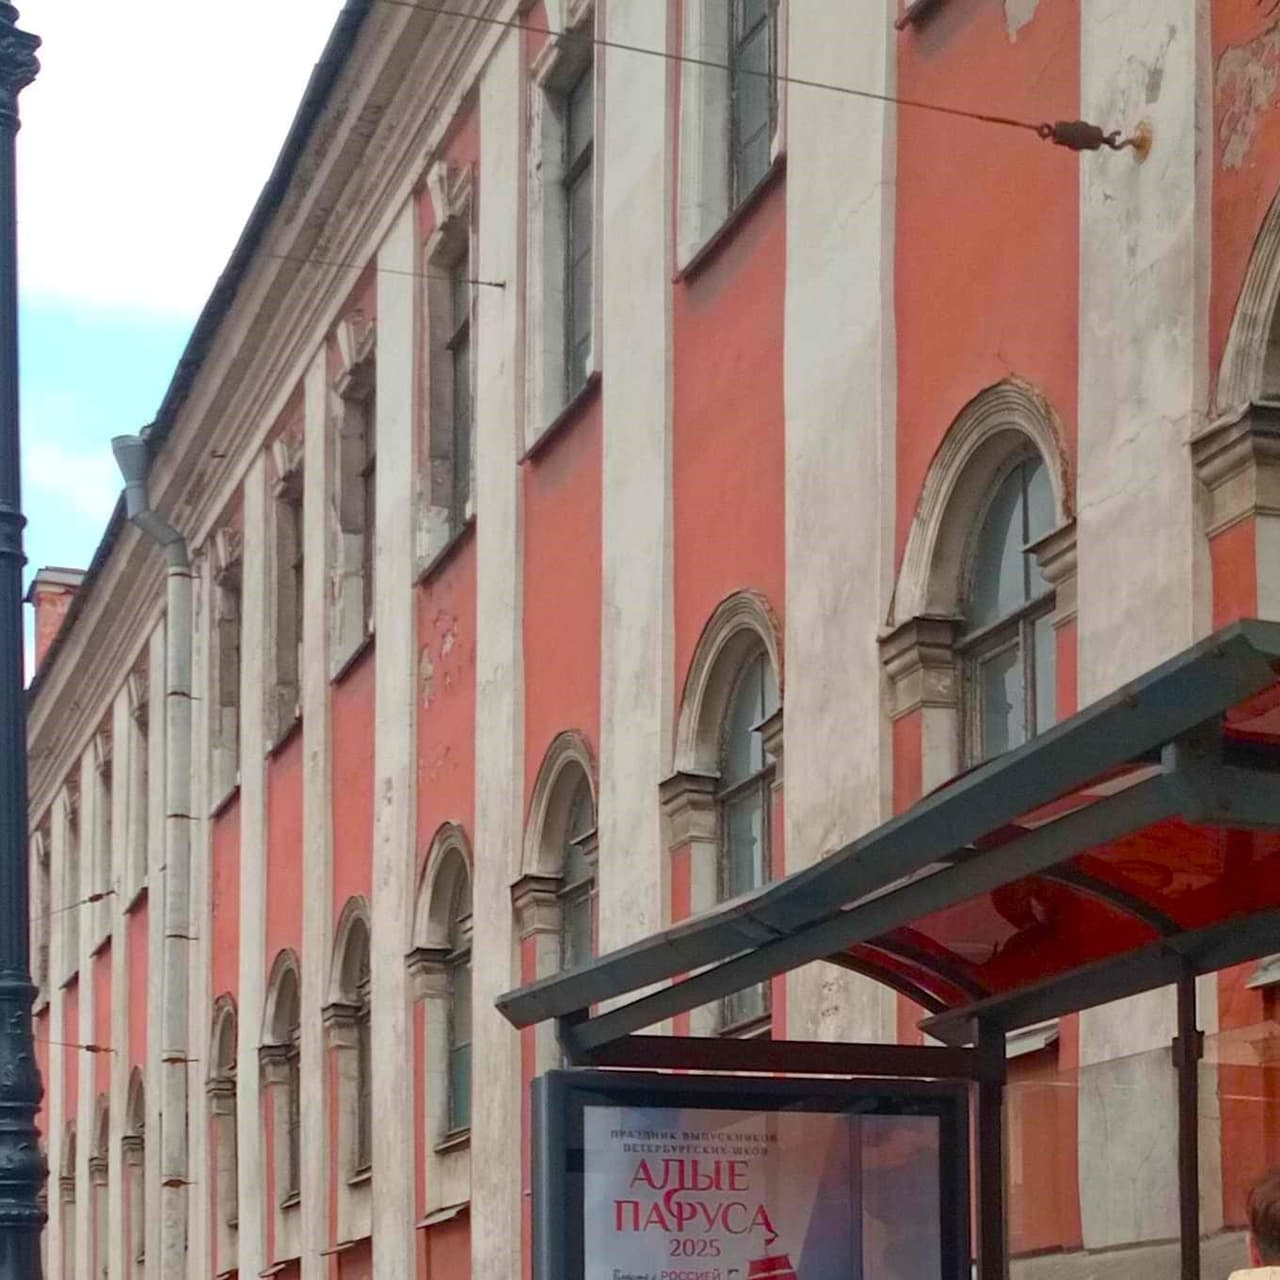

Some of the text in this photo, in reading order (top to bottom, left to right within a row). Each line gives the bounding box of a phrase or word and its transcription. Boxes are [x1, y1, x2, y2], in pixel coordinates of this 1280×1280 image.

[629, 1158, 749, 1192] АЛЫЕ
[613, 1190, 778, 1235] ПАРУСА
[669, 1239, 721, 1258] 2025
